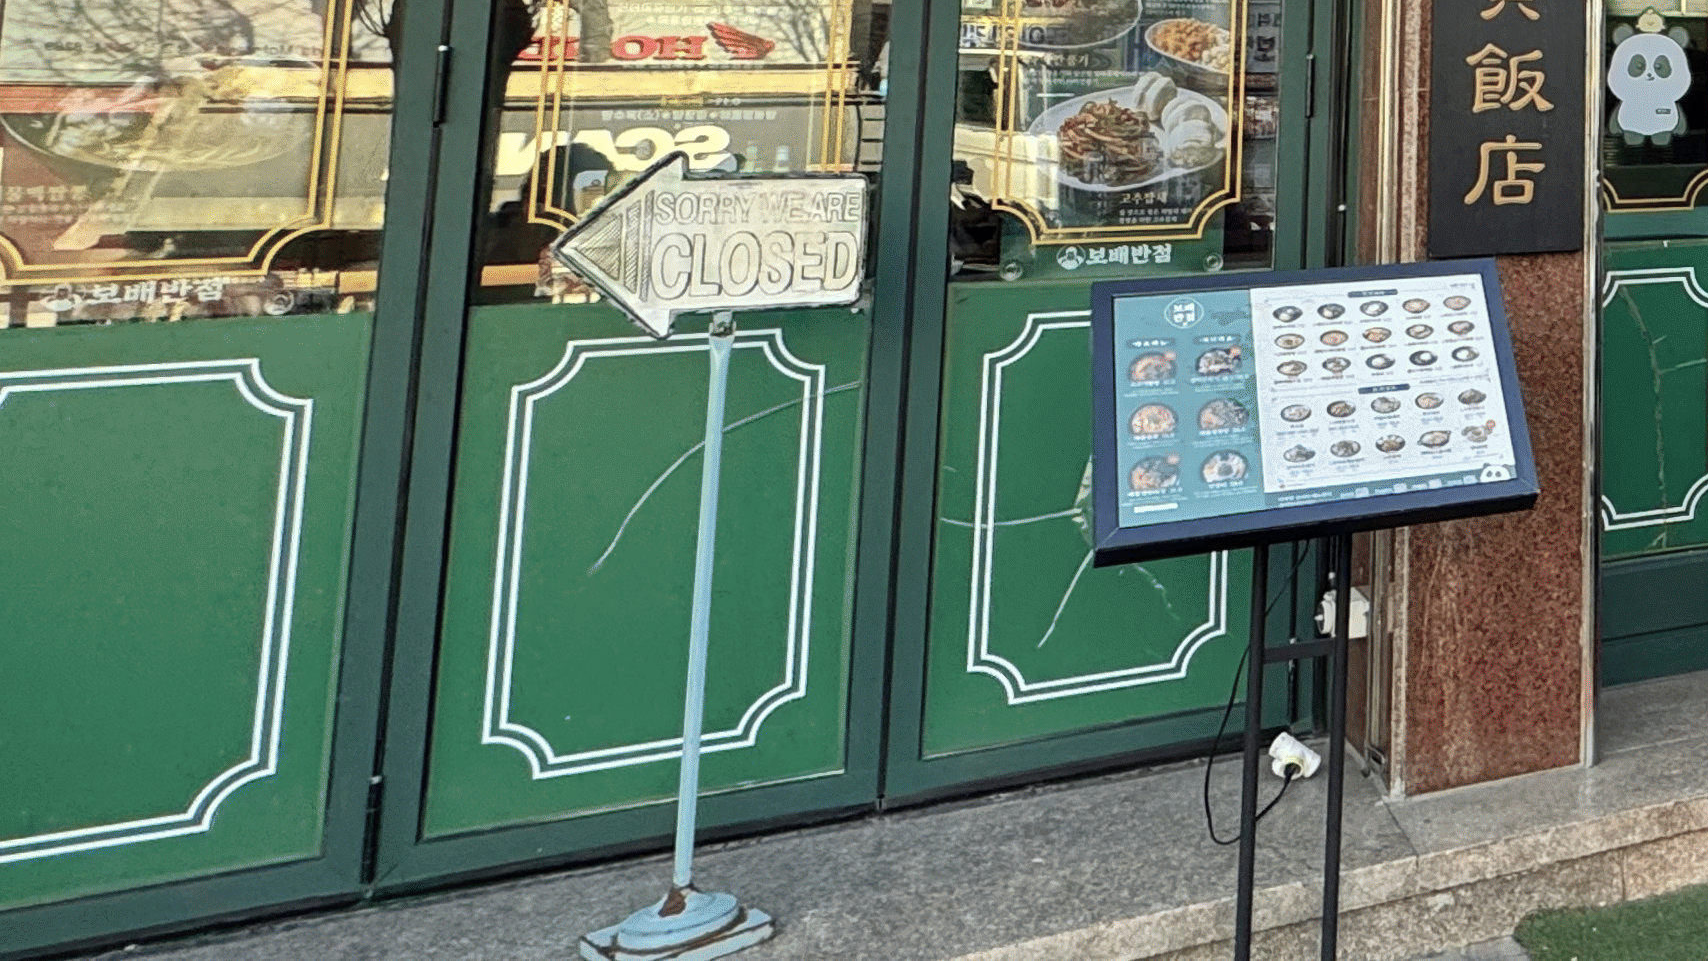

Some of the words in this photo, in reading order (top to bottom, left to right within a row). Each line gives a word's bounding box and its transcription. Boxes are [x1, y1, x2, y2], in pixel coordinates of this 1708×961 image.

[654, 191, 751, 225] SORRY
[810, 191, 861, 224] ARE
[650, 230, 860, 302] CLOSED
[1085, 242, 1173, 266] 보배반점
[86, 279, 230, 306] 보배반점
